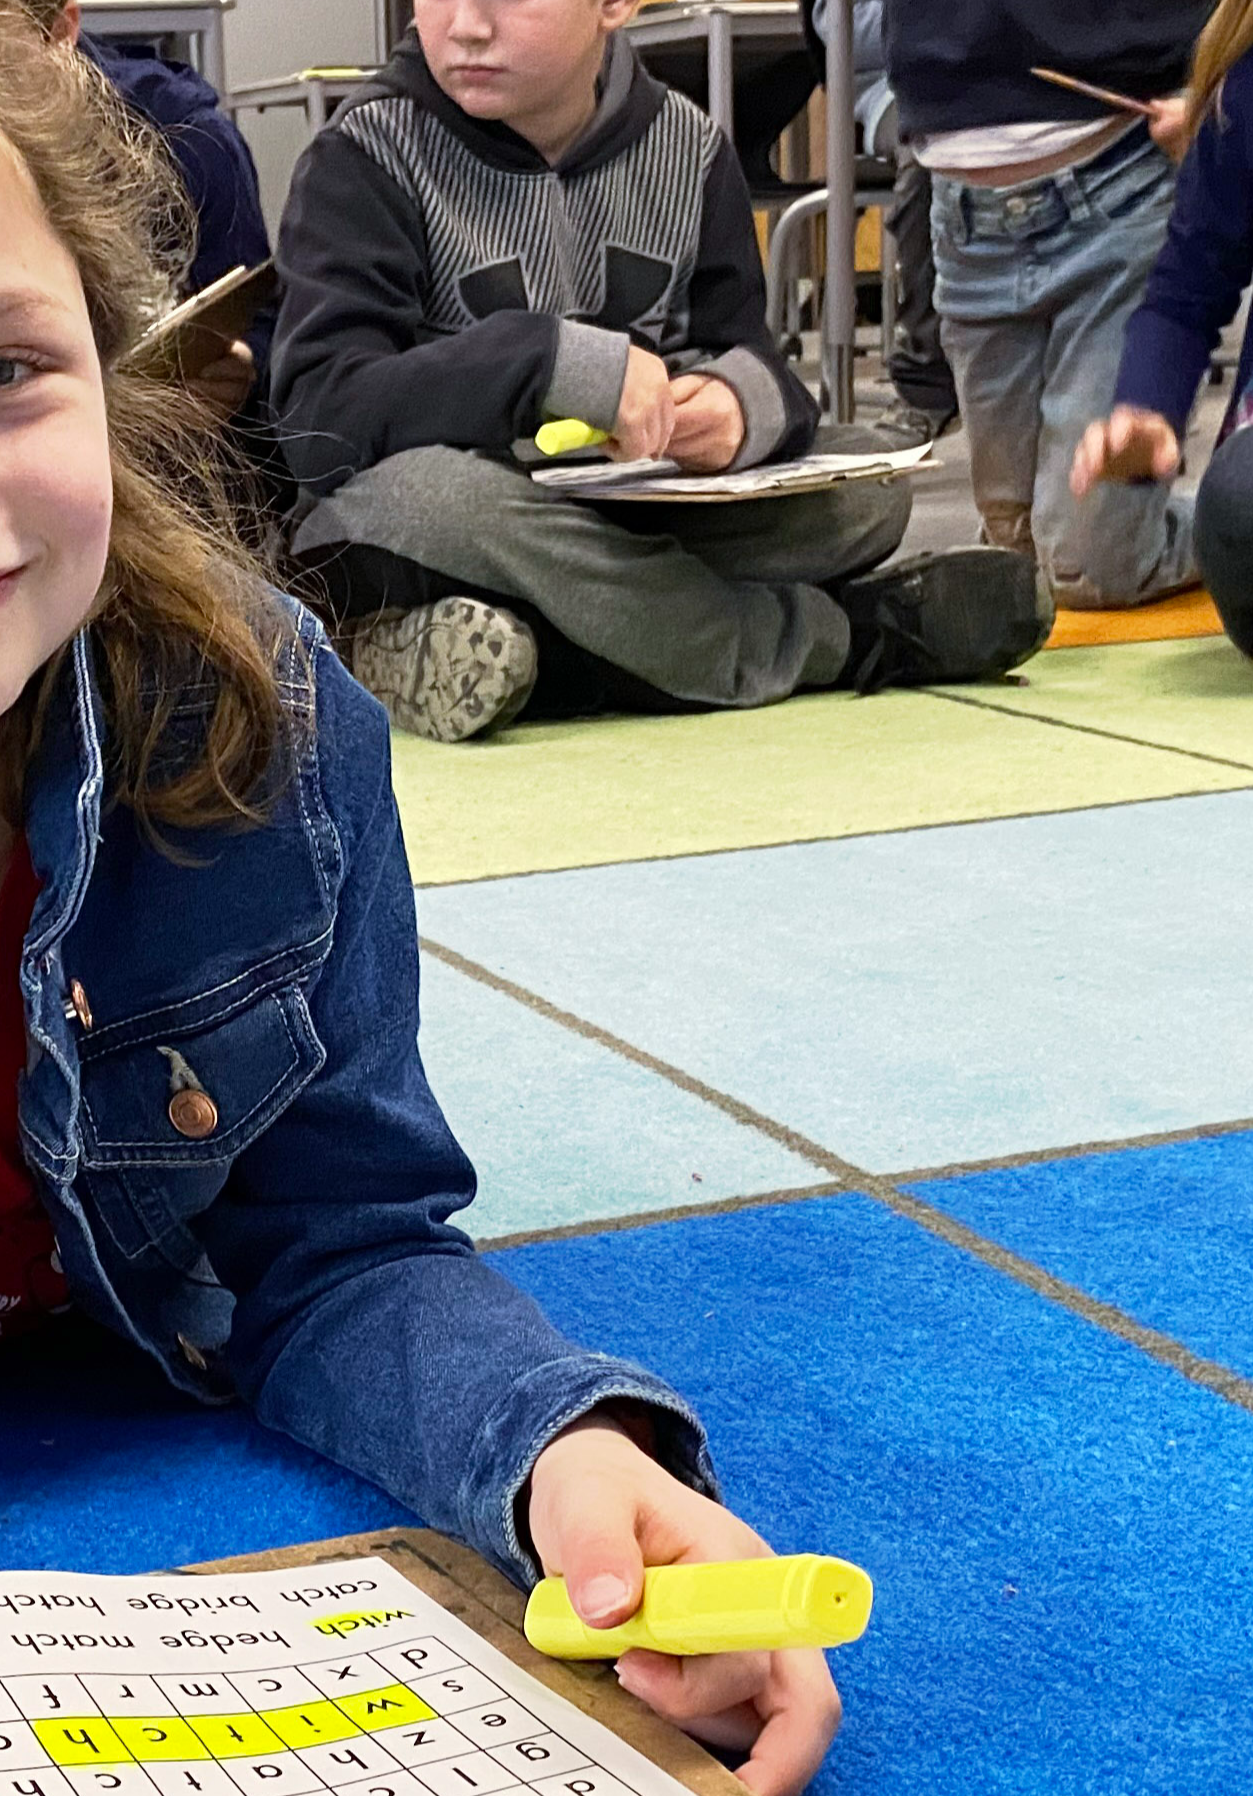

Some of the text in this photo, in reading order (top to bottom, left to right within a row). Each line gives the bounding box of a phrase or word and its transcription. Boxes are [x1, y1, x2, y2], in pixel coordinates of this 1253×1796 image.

[279, 1579, 379, 1608] catch
[126, 1592, 261, 1618] bridge
[313, 1609, 416, 1640] witch
[10, 1633, 136, 1656] match
[159, 1629, 292, 1656] hedge
[400, 1648, 428, 1670] d
[326, 1664, 360, 1681] x
[119, 1684, 135, 1699] r
[178, 1683, 220, 1697] m
[257, 1678, 283, 1692] c
[441, 1679, 465, 1693] s
[42, 1684, 62, 1710] f
[366, 1697, 405, 1715] w
[480, 1713, 507, 1728] e
[61, 1727, 101, 1754] h
[141, 1727, 168, 1742] c
[225, 1723, 245, 1743] t
[401, 1730, 436, 1747] z
[328, 1749, 369, 1770] h
[515, 1741, 551, 1762] g
[94, 1773, 122, 1789] c
[182, 1770, 203, 1791] t
[251, 1764, 283, 1779] a
